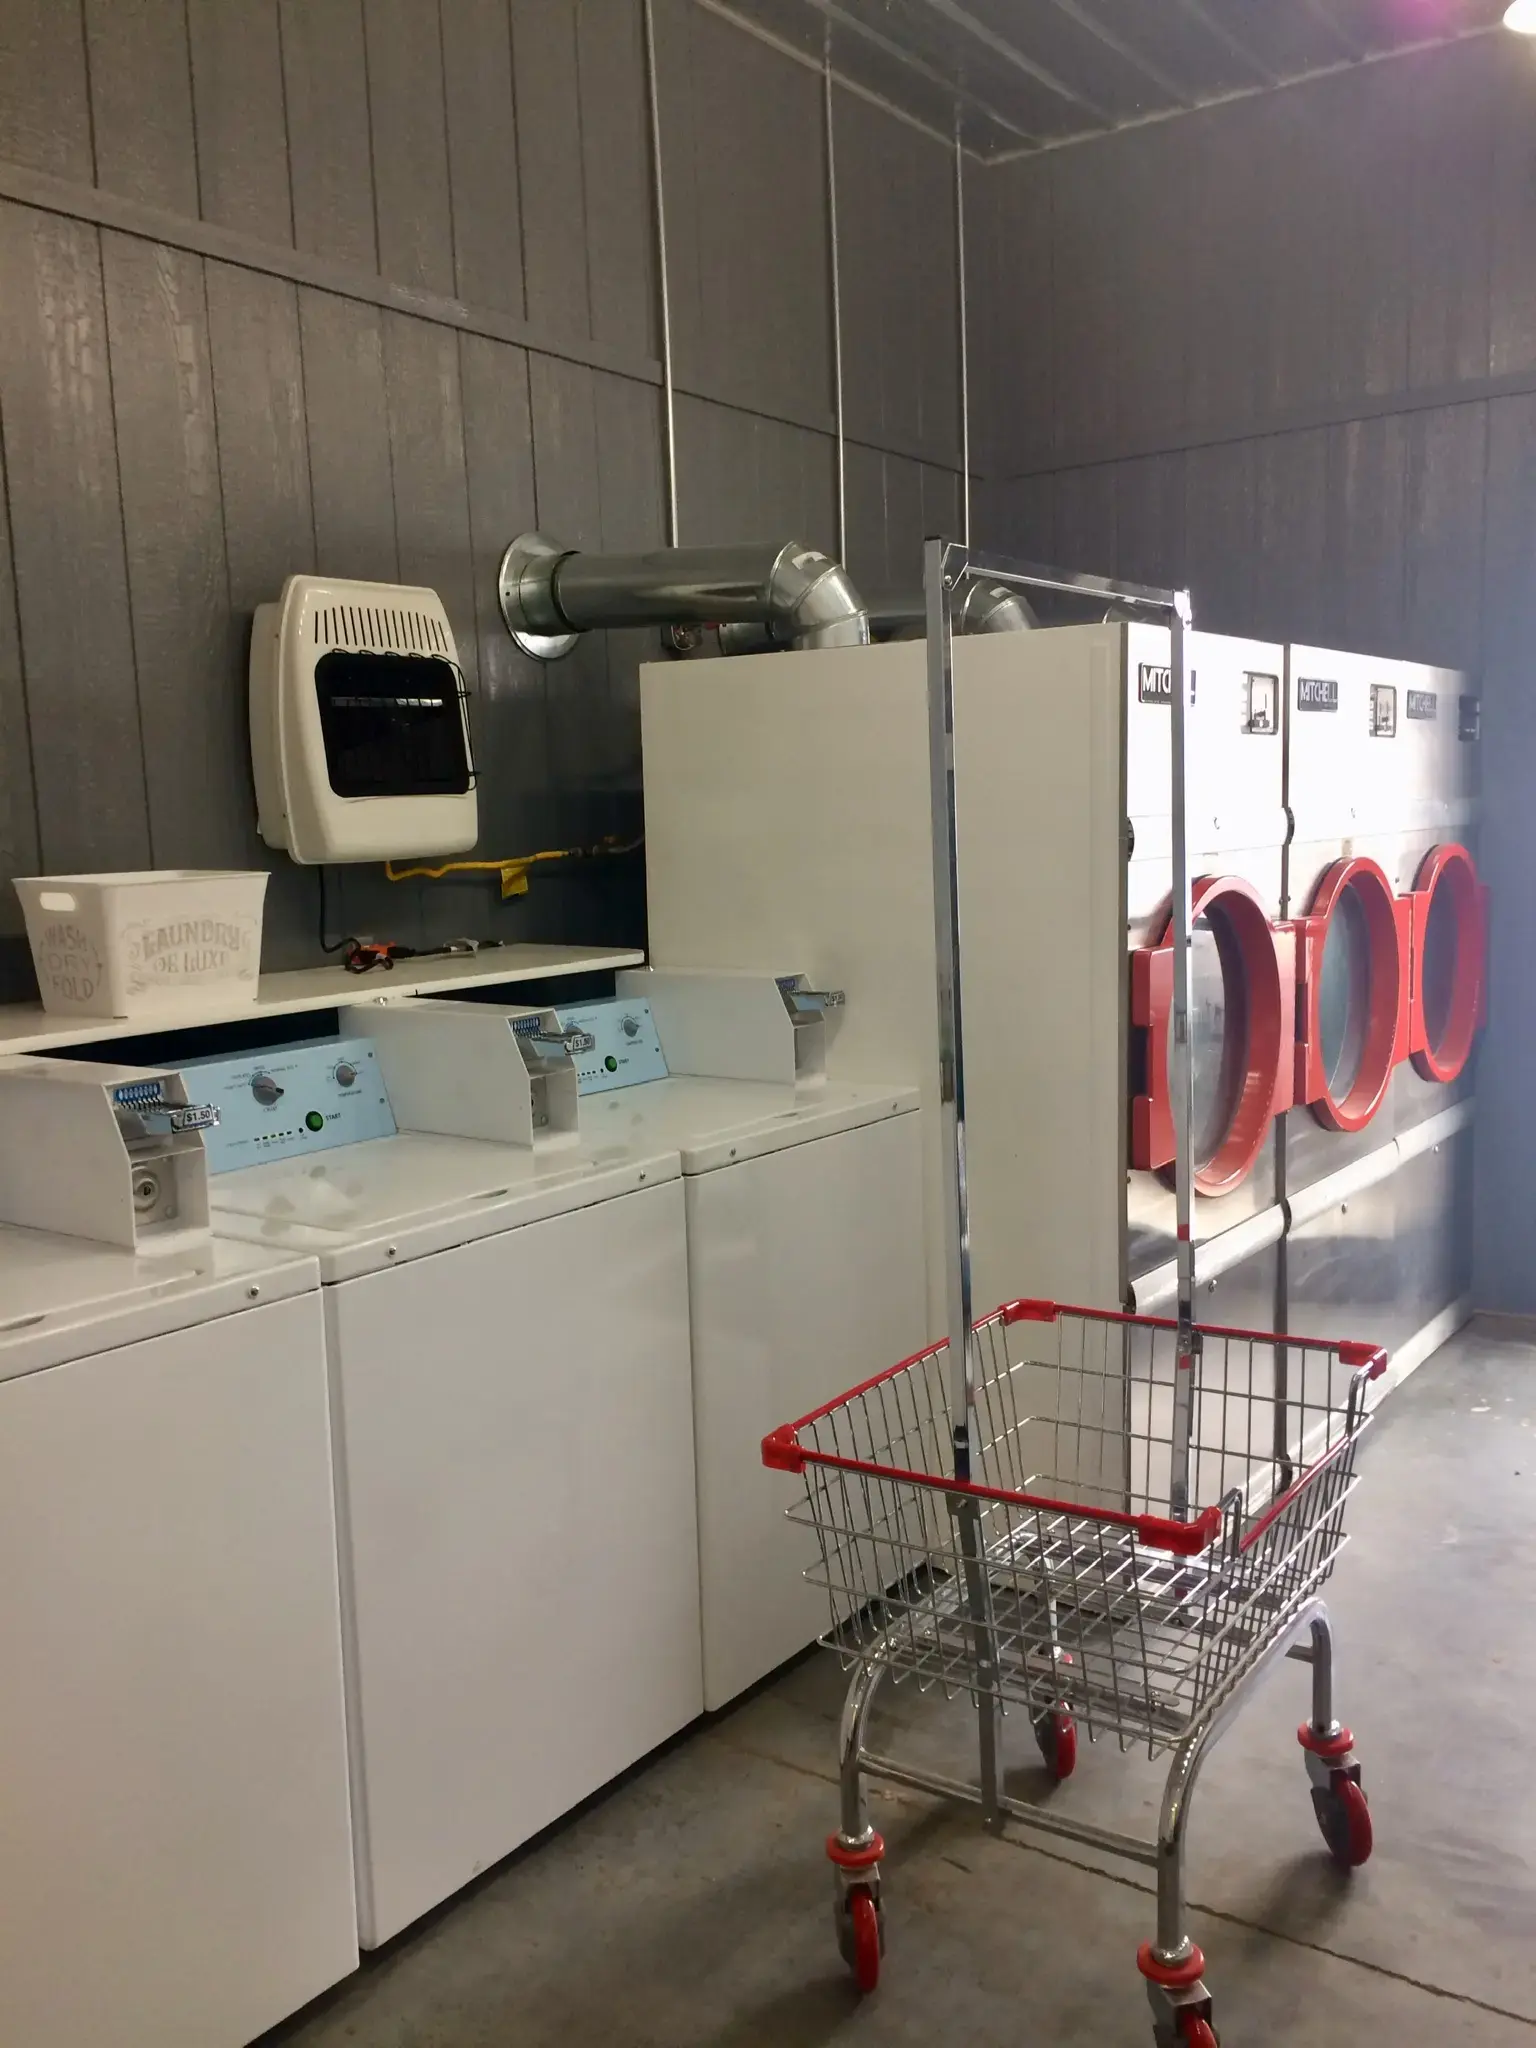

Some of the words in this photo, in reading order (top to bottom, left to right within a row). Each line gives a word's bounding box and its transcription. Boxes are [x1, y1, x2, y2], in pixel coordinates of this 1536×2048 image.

[1300, 681, 1337, 703] MITCHELL
[52, 975, 94, 1003] FOLD
[186, 1110, 211, 1122] $1.50
[325, 1112, 341, 1121] START
